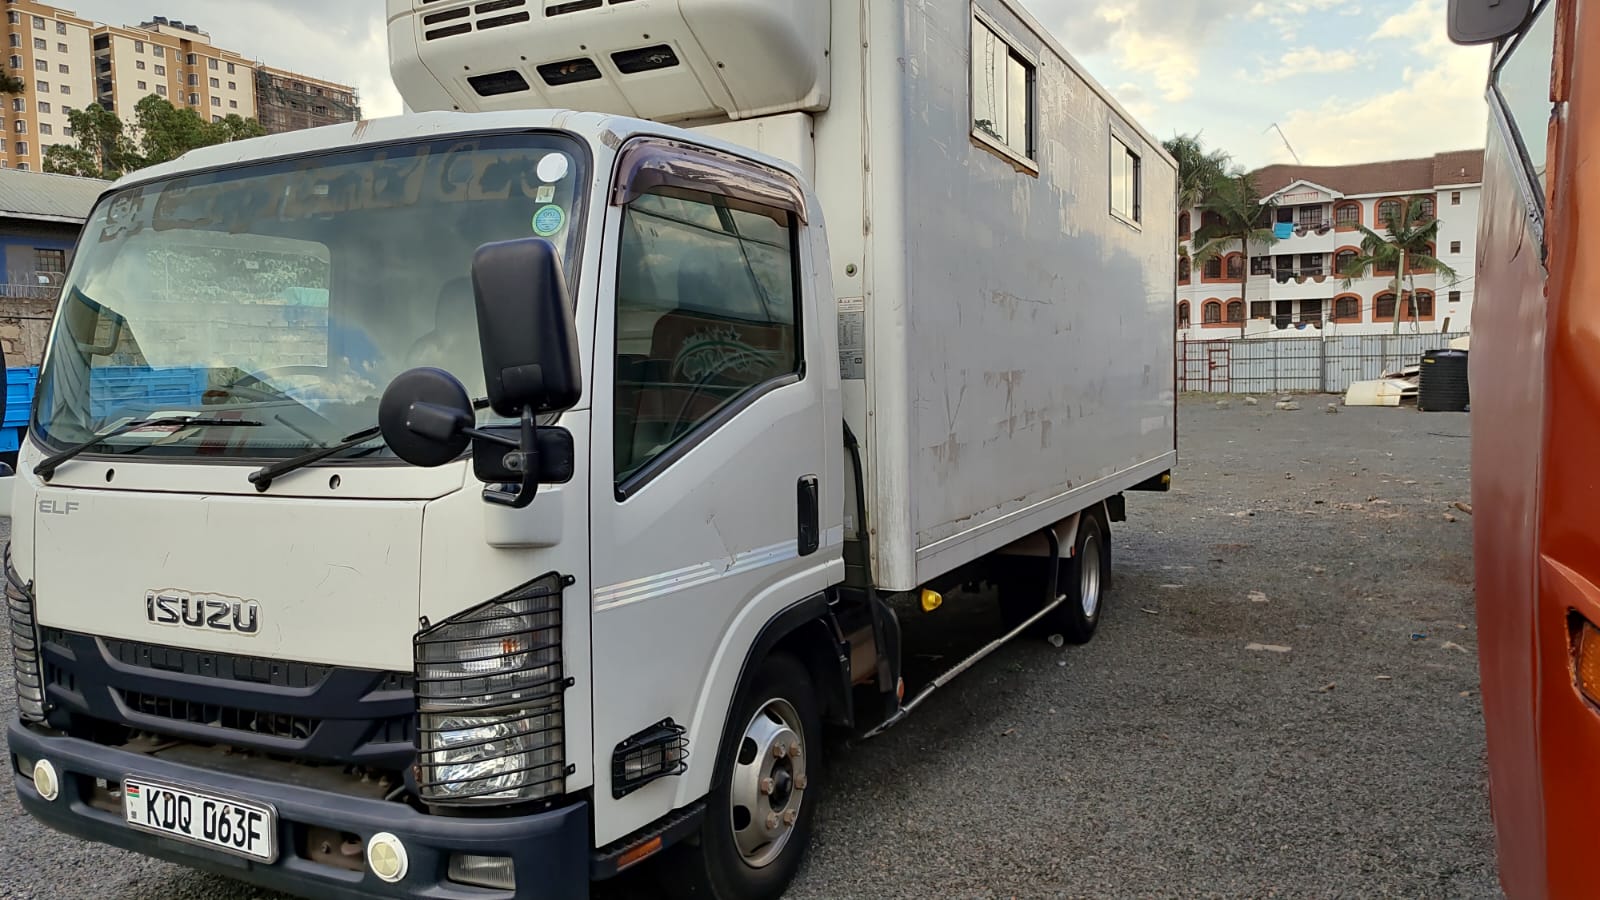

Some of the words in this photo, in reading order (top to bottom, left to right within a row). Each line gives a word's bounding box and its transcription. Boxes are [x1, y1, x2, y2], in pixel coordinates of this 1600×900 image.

[39, 500, 79, 515] ELF
[146, 594, 258, 633] ISUZU
[147, 788, 192, 834] KDQ
[203, 801, 262, 850] 063F
